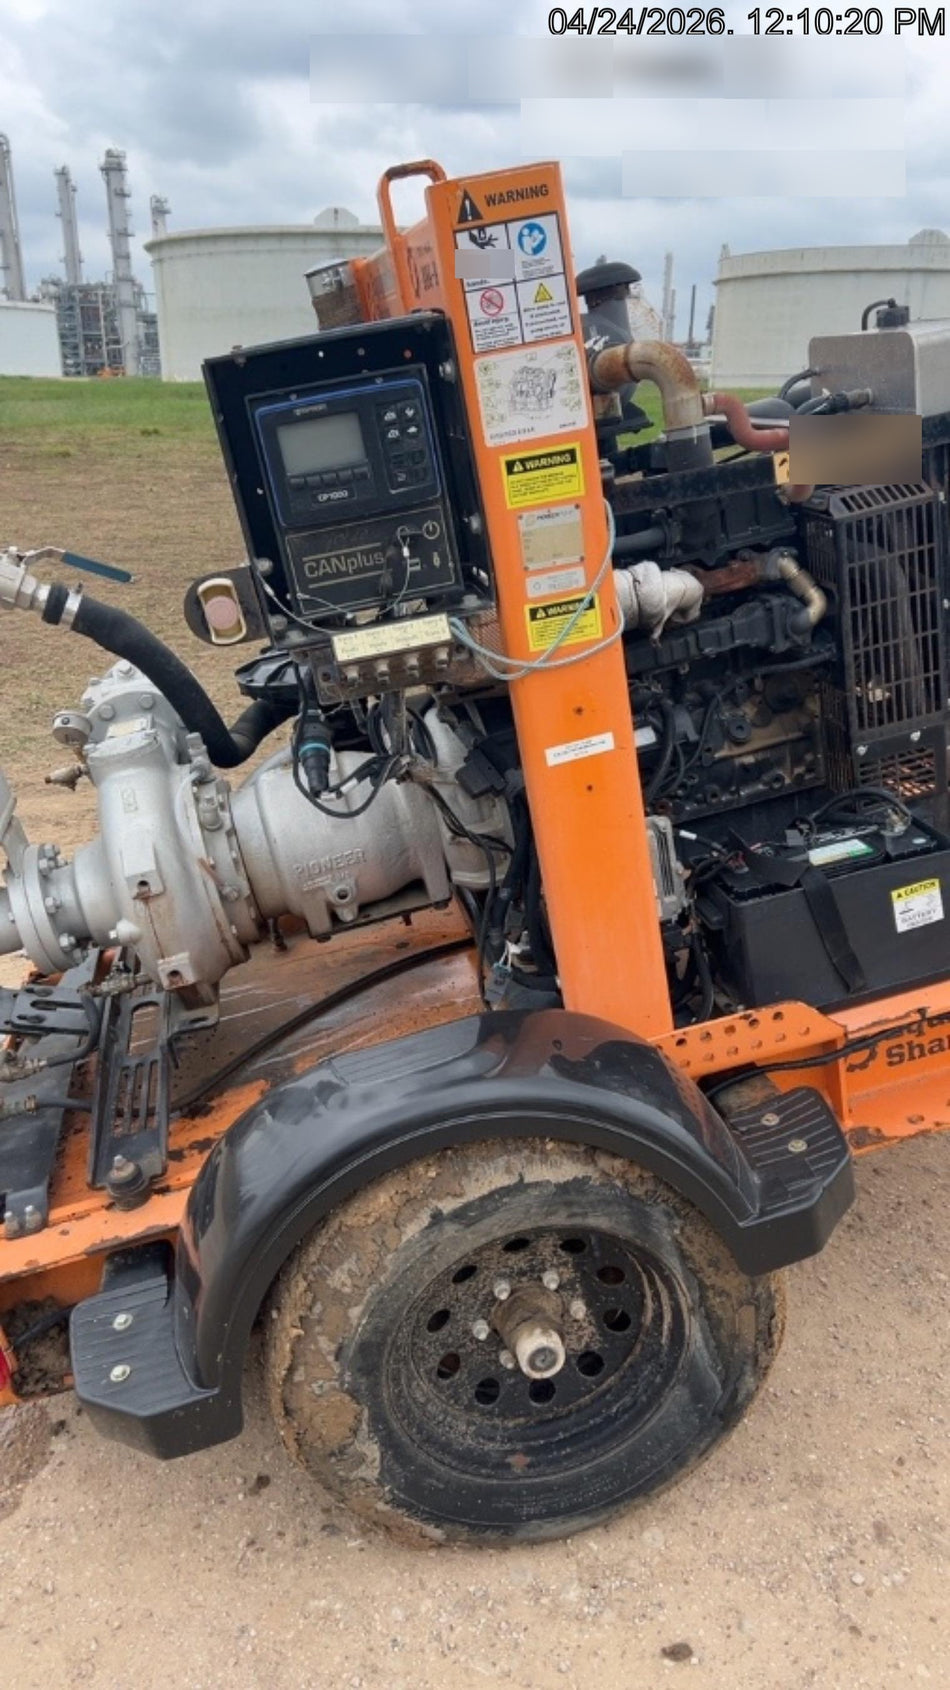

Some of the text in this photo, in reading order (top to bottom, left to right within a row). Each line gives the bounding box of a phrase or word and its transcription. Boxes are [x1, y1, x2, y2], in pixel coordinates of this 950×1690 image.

[484, 183, 549, 207] WARNING
[524, 452, 572, 471] WARNING
[303, 550, 385, 579] CANplus
[293, 848, 367, 879] PIONEER
[904, 881, 937, 897] CAUTION
